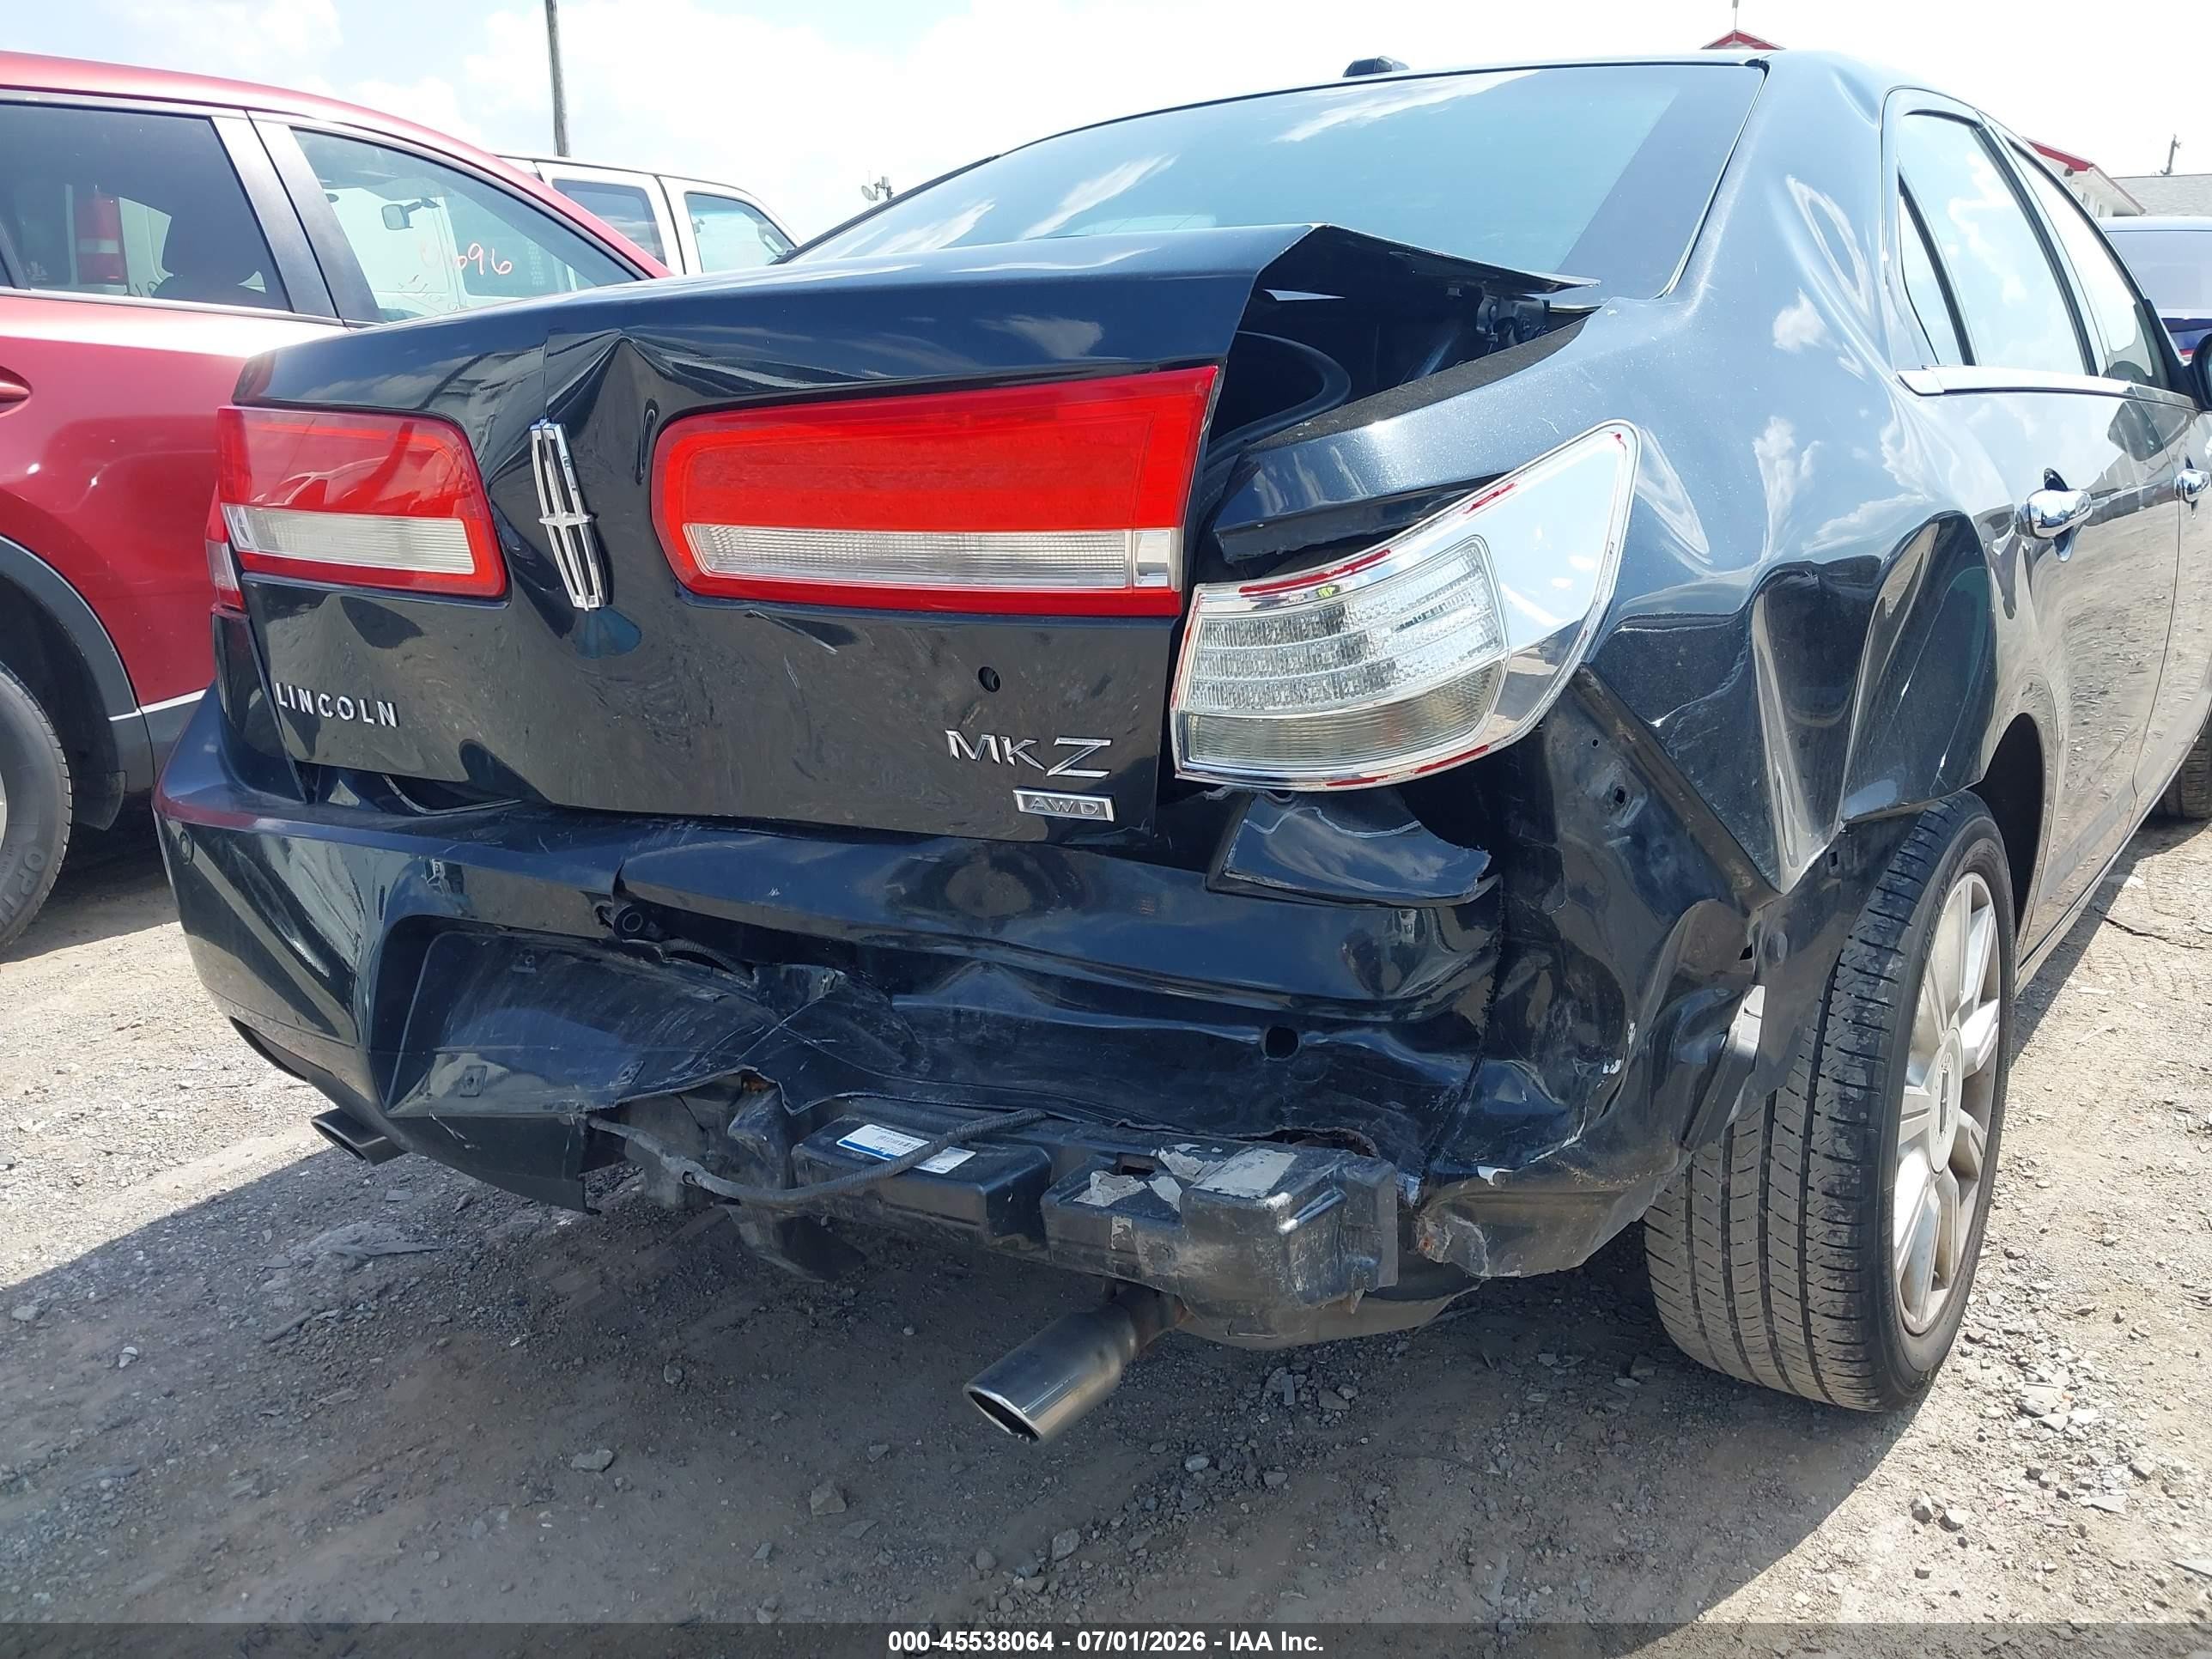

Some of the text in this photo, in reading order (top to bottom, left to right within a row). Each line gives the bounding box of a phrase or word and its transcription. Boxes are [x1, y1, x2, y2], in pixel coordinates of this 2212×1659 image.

[275, 682, 398, 728] LINCOLN
[945, 729, 1112, 778] MKZ
[1030, 797, 1100, 816] AWD
